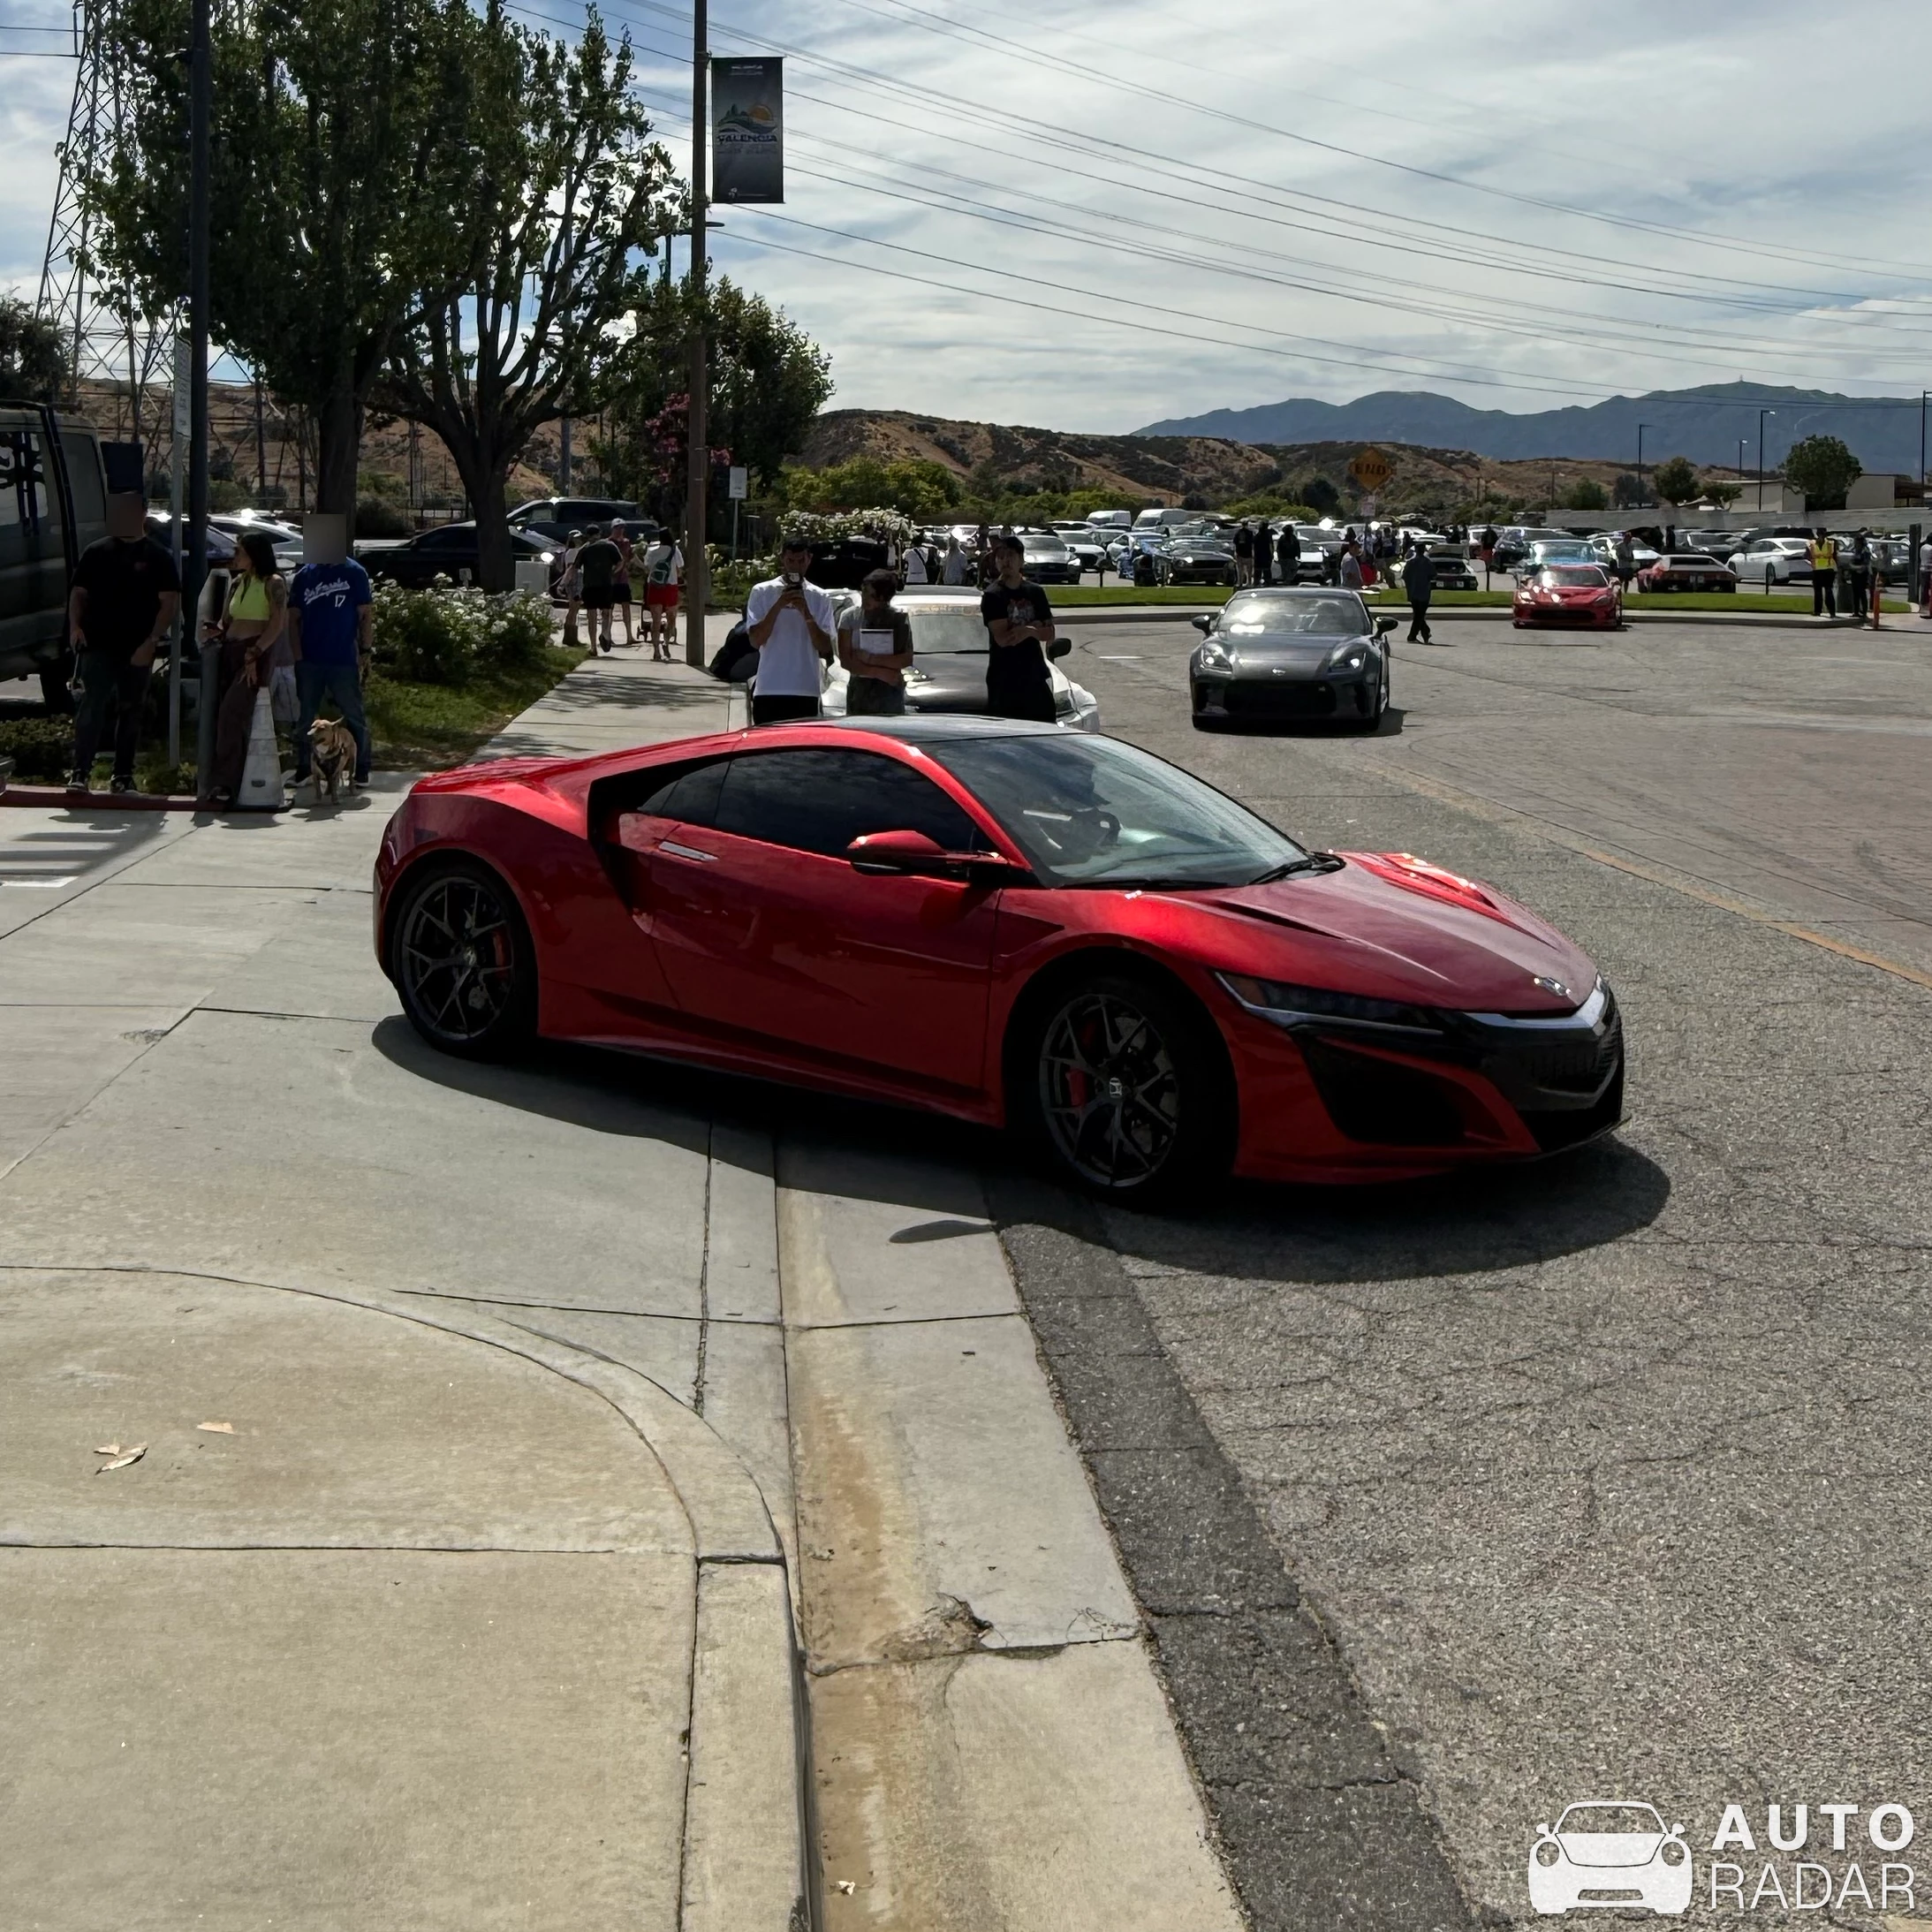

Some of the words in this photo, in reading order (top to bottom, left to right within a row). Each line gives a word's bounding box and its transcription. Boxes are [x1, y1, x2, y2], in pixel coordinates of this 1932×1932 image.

[717, 133, 777, 145] VALENCIA
[1354, 464, 1386, 474] END
[335, 595, 346, 608] 17
